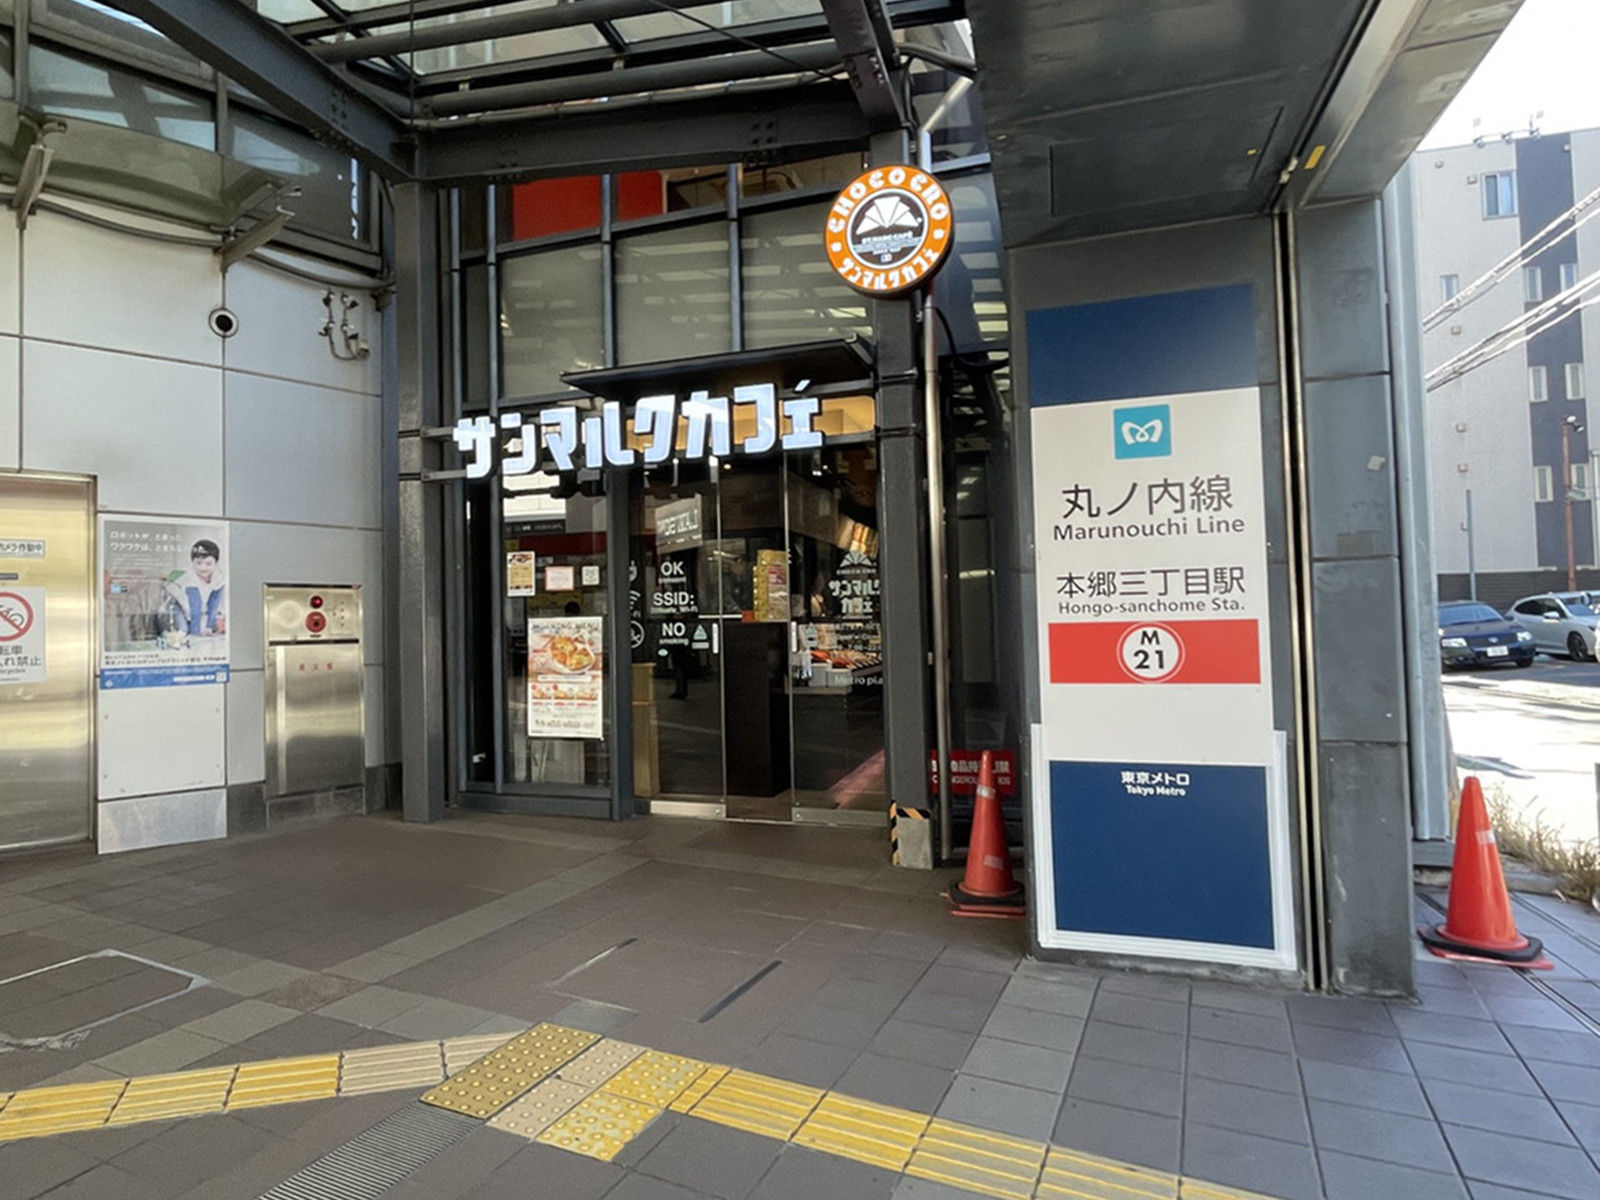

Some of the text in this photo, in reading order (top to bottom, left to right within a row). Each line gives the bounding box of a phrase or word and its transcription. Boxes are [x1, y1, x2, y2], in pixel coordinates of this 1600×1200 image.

[837, 247, 940, 291] サンマルクカフェ
[453, 379, 823, 479] サンマルクカフェ
[1062, 475, 1233, 519] 丸ノ内線
[1053, 515, 1245, 541] Marunouchi Line
[660, 561, 684, 576] OK
[1056, 566, 1246, 599] 本郷三丁目駅
[652, 591, 695, 606] SSID:
[1058, 597, 1245, 618] Hongo-sanchome Sta.
[662, 622, 686, 637] NO
[1140, 629, 1161, 646] M
[1133, 649, 1165, 670] 21
[1120, 770, 1190, 786] 東京メトロ
[1125, 784, 1187, 797] Tokyo Metro
